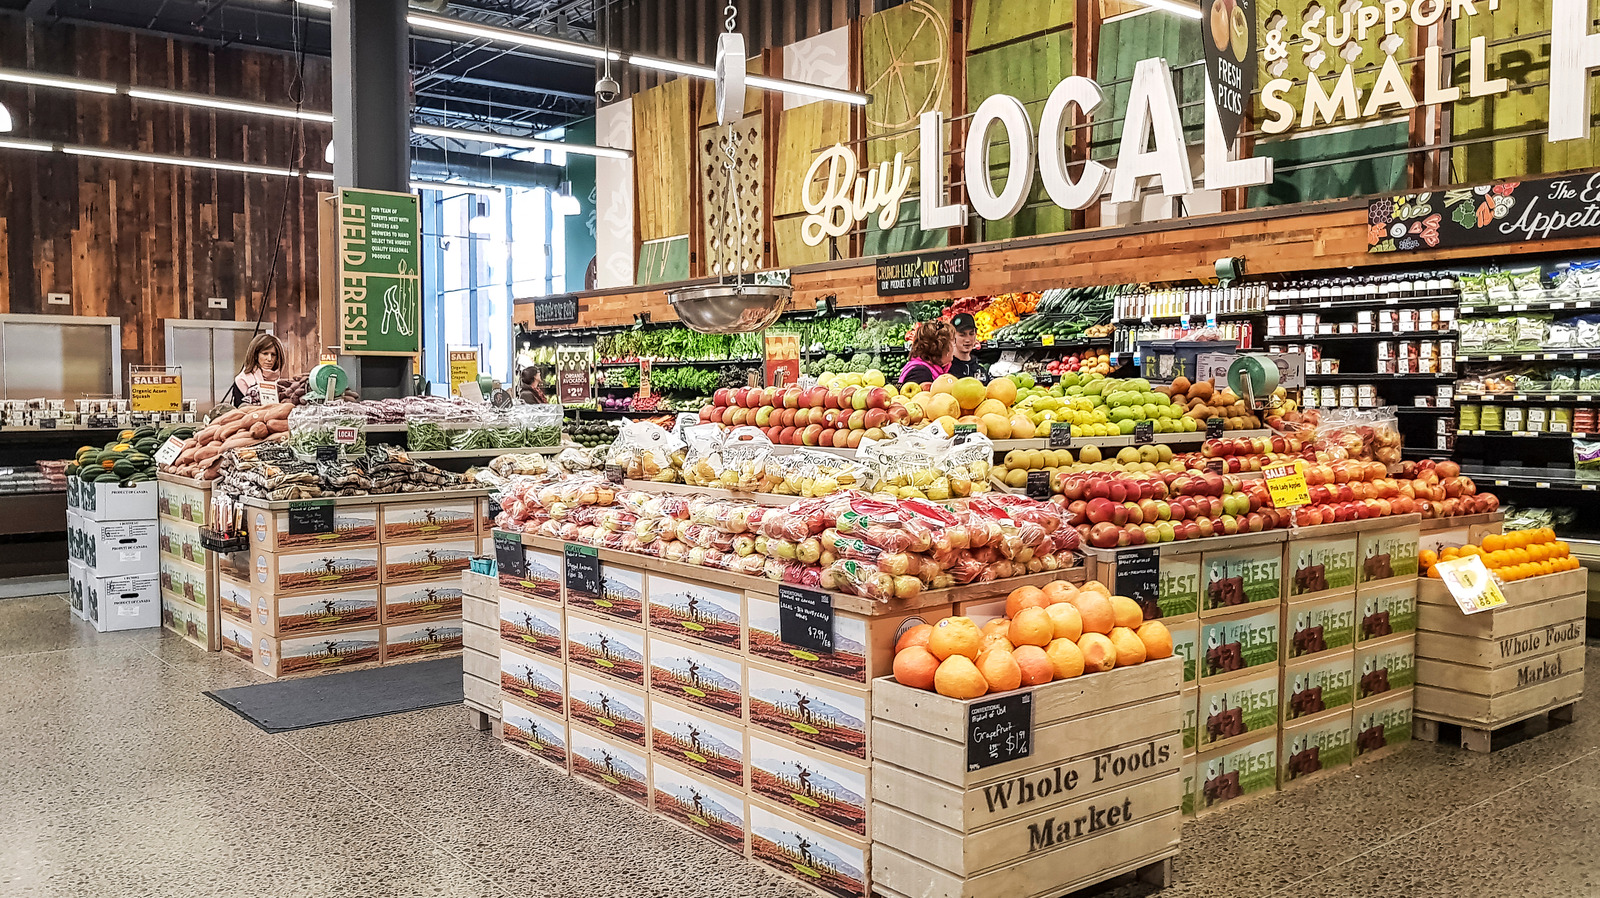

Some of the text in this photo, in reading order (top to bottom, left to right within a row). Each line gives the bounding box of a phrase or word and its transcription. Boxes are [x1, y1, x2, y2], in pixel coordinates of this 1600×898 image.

[1264, 30, 1288, 62] &
[1218, 58, 1242, 90] FRESH
[1261, 37, 1508, 133] SMALL
[1218, 86, 1242, 115] PICKS
[801, 57, 1273, 246] Buy LOCAL
[1548, 180, 1577, 200] The
[343, 204, 366, 266] FIELD
[878, 264, 900, 280] CRUNCH
[920, 260, 940, 278] JUICY
[944, 258, 965, 274] SWEET
[890, 279, 905, 289] PRODUCE
[907, 279, 911, 287] IS
[940, 275, 945, 284] TO
[344, 272, 367, 345] FRESH
[134, 376, 162, 384] SALE!
[339, 430, 354, 438] LOCAL
[799, 452, 844, 470] ORGANIC
[1265, 466, 1287, 479] SALE!
[1323, 551, 1354, 570] BEST
[1389, 542, 1417, 560] BEST
[1242, 562, 1278, 584] BEST
[603, 586, 624, 602] FRESH
[669, 603, 718, 625] FIELD FRESH
[1388, 597, 1415, 616] BEST
[1323, 611, 1352, 632] BEST
[1240, 625, 1275, 648] BEST
[1500, 623, 1580, 658] Whole Foods
[1387, 653, 1413, 673] BEST
[1517, 653, 1562, 686] Market
[670, 667, 719, 691] FIELD FRESH
[1321, 670, 1351, 692] BEST
[1240, 689, 1276, 712] BEST
[774, 701, 835, 729] FIELD FRESH
[989, 710, 995, 718] of
[1384, 708, 1411, 729] BEST
[973, 722, 1016, 743] Grapefruit
[1319, 729, 1349, 750] BEST
[672, 731, 720, 759] FIELD FRESH
[1238, 751, 1274, 775] BEST
[775, 772, 836, 803] FIELD FRESH
[982, 742, 1171, 813] Whole Foods
[674, 794, 722, 824] FIELD FRESH
[1027, 796, 1132, 852] Market
[776, 840, 837, 875] FIELD FRESH
